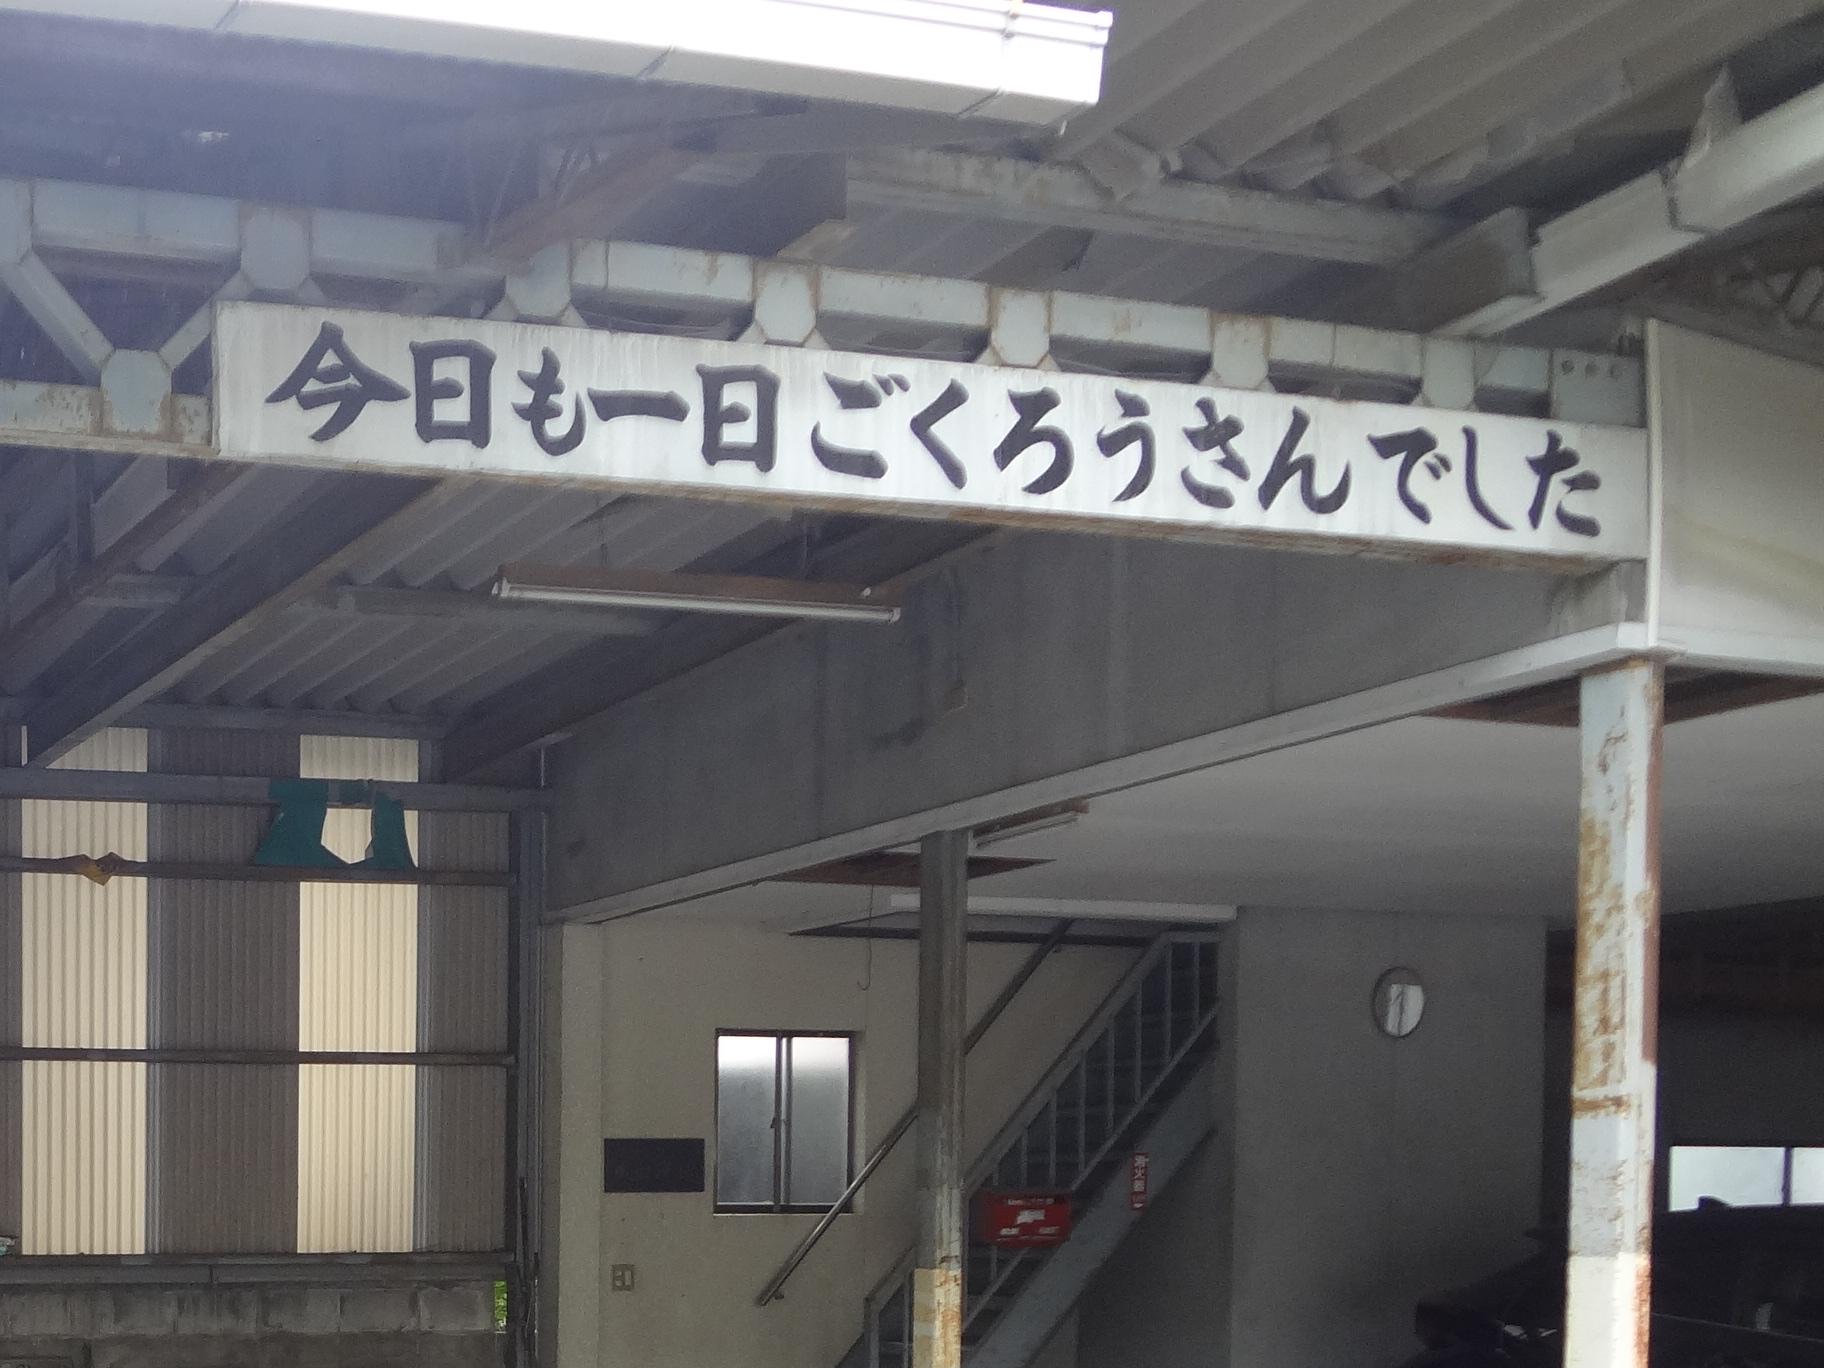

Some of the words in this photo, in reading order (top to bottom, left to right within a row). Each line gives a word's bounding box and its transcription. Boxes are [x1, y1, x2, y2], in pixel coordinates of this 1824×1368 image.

[263, 319, 1602, 538] 今日も一日ごくろうさんでした
